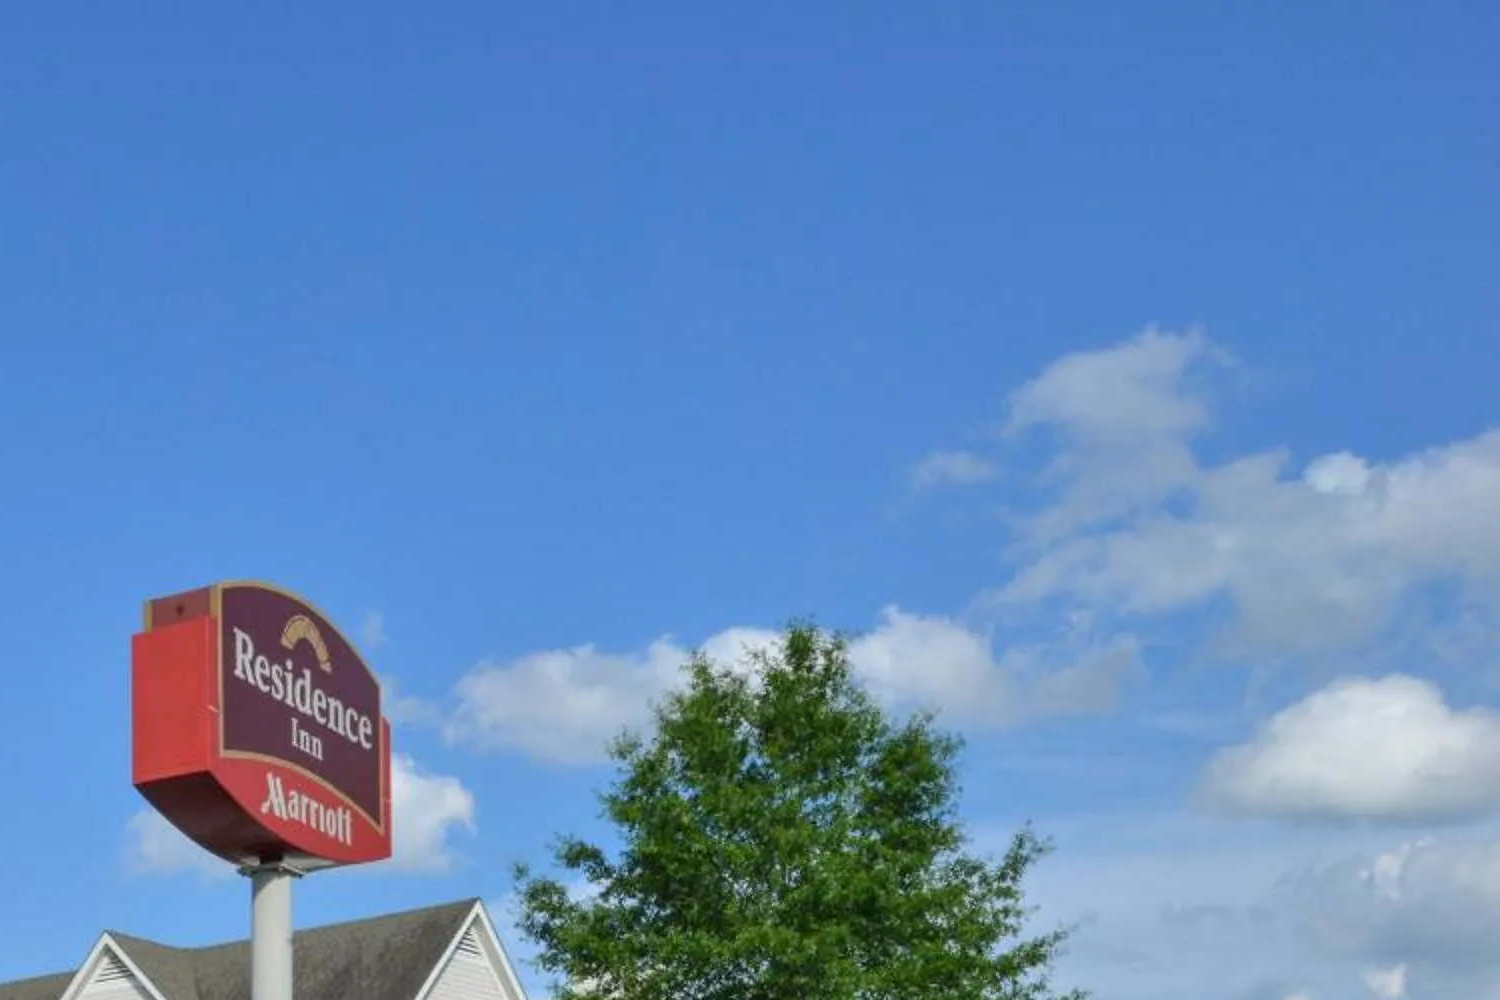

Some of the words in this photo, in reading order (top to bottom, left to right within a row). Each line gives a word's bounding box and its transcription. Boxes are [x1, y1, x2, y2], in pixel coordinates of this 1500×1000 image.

[233, 627, 373, 749] Residence
[291, 717, 323, 760] Inn
[261, 772, 351, 845] Marriott
